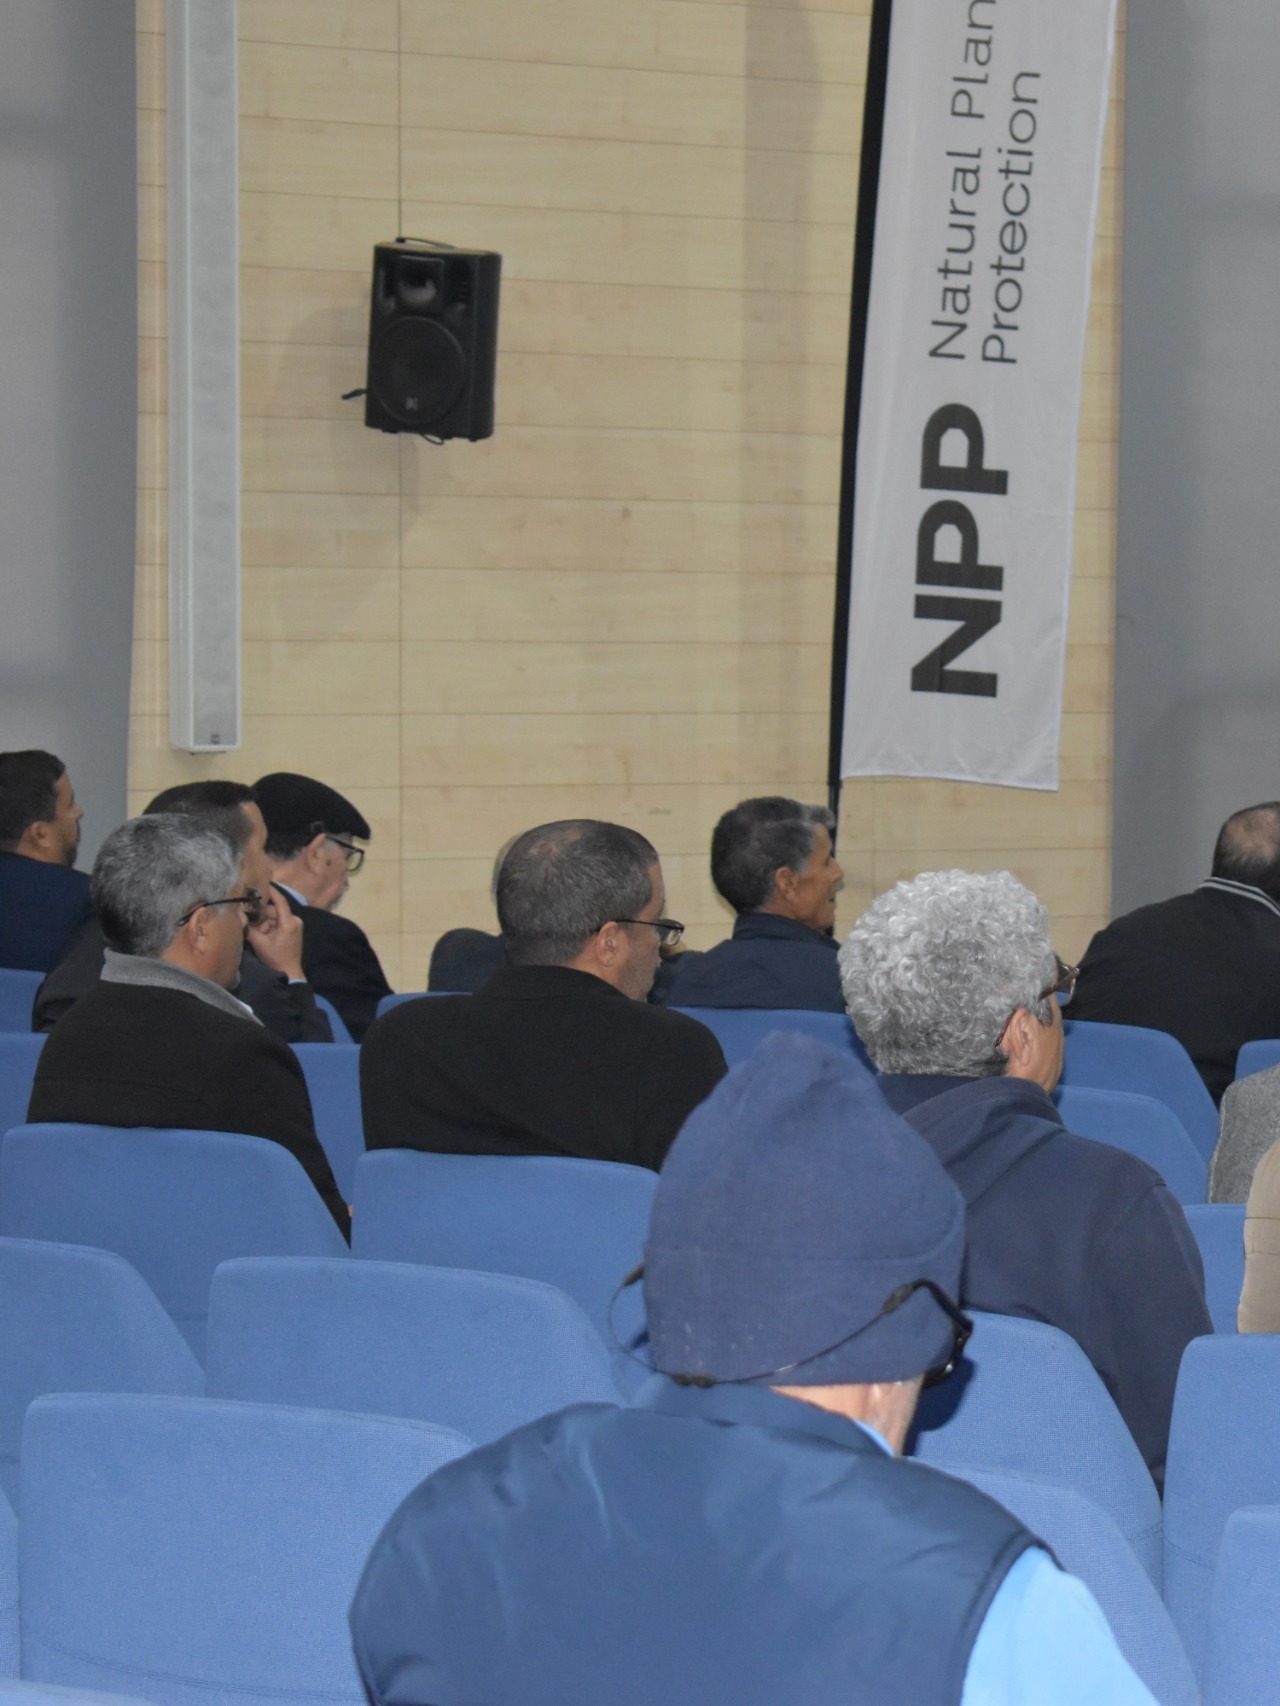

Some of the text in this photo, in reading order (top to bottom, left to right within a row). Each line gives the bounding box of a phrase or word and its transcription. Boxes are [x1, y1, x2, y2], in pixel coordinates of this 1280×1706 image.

[929, 148, 982, 360] Natural
[981, 72, 1041, 364] Protection
[910, 402, 1009, 699] NPP
